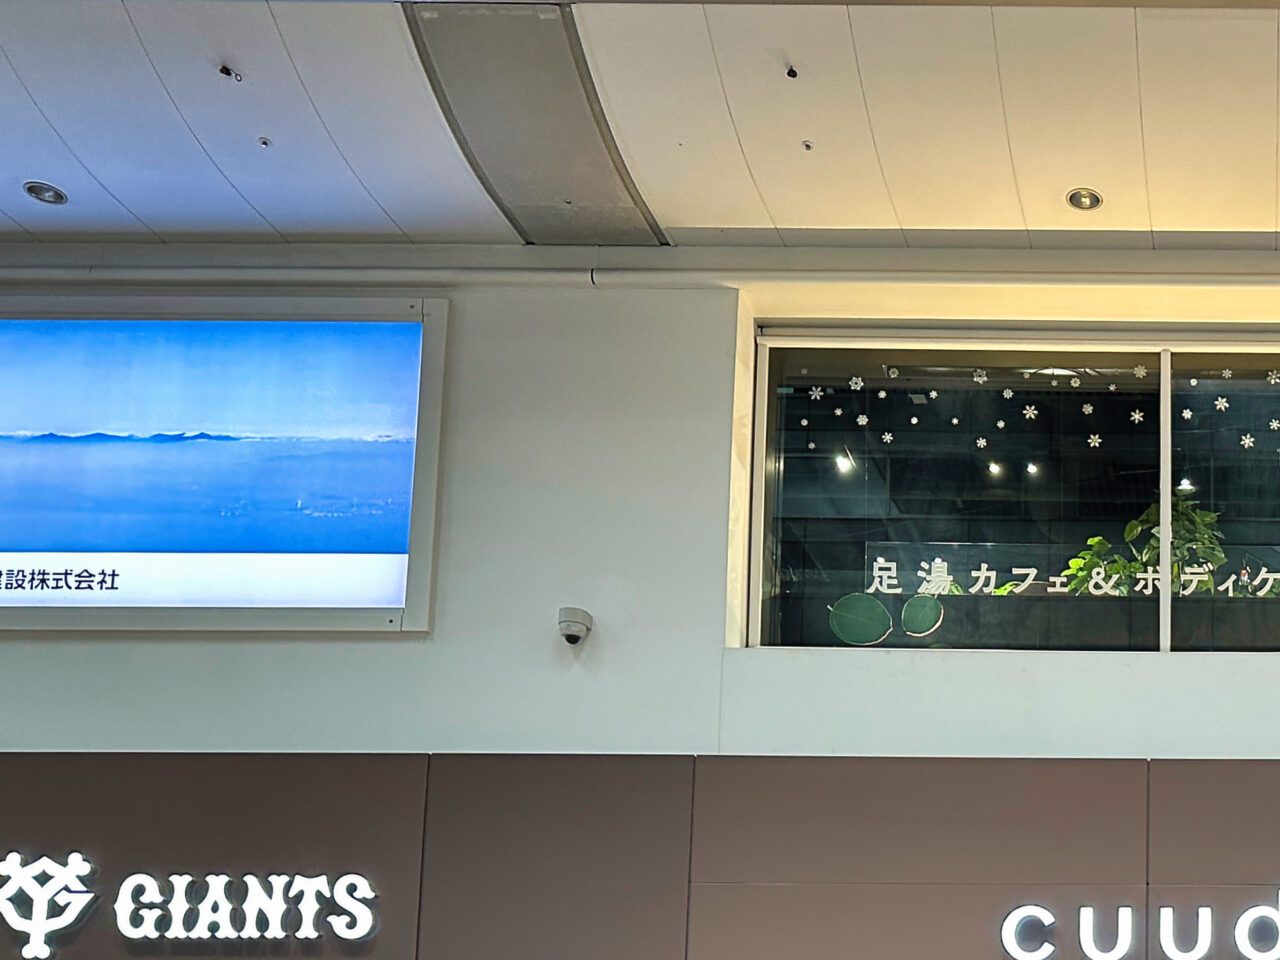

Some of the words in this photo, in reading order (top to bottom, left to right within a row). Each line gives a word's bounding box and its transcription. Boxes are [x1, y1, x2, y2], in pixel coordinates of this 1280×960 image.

[0, 568, 120, 591] 設株式会社
[115, 873, 376, 940] GIANTS
